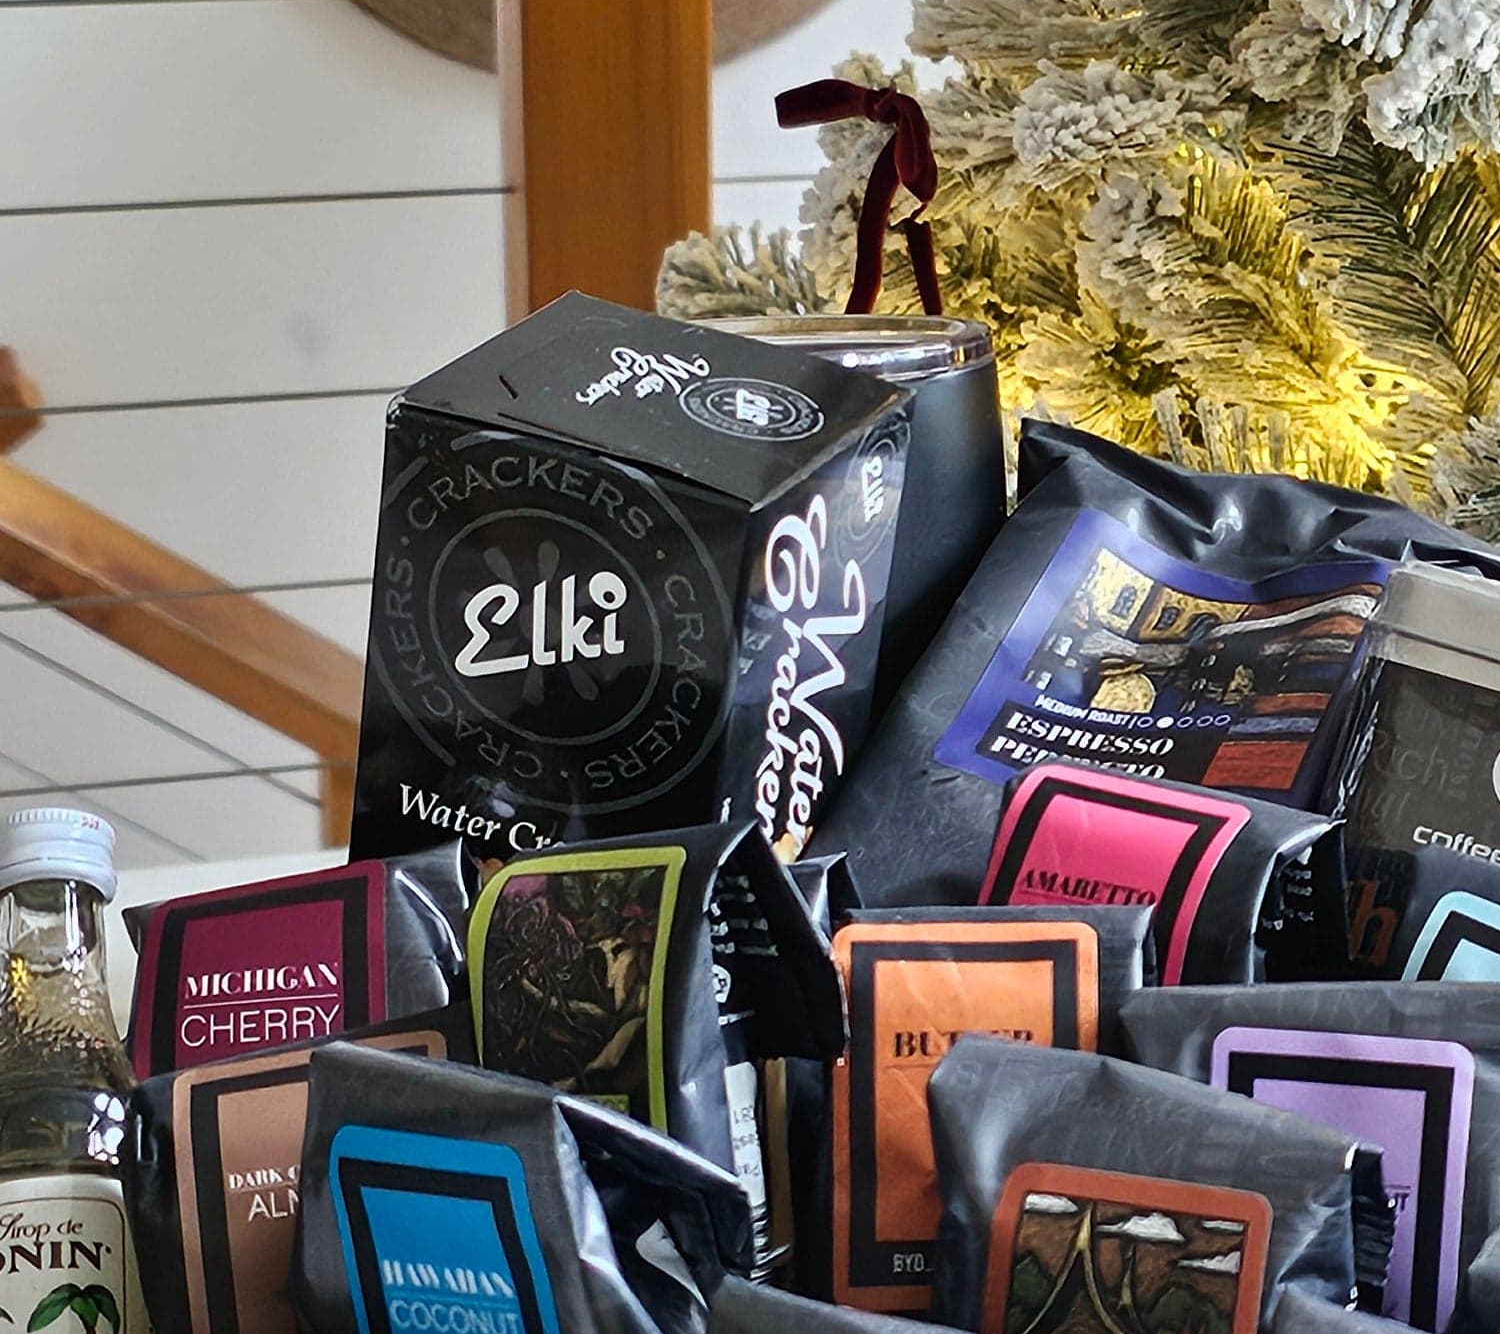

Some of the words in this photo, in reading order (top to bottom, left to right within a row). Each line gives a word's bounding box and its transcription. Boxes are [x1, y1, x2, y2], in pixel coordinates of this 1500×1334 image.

[405, 454, 656, 542] CRACKERS
[454, 571, 627, 677] Elki
[382, 553, 529, 779] CRACKERS
[588, 572, 703, 790] CRACKERS
[1005, 712, 1175, 756] ESPRESSO
[398, 783, 502, 839] Water
[1023, 869, 1157, 905] AMARETTO
[184, 961, 340, 1000] MICHIGAN
[180, 1003, 341, 1048] CHERRY
[228, 1167, 284, 1191] DARK
[56, 1219, 84, 1236] de
